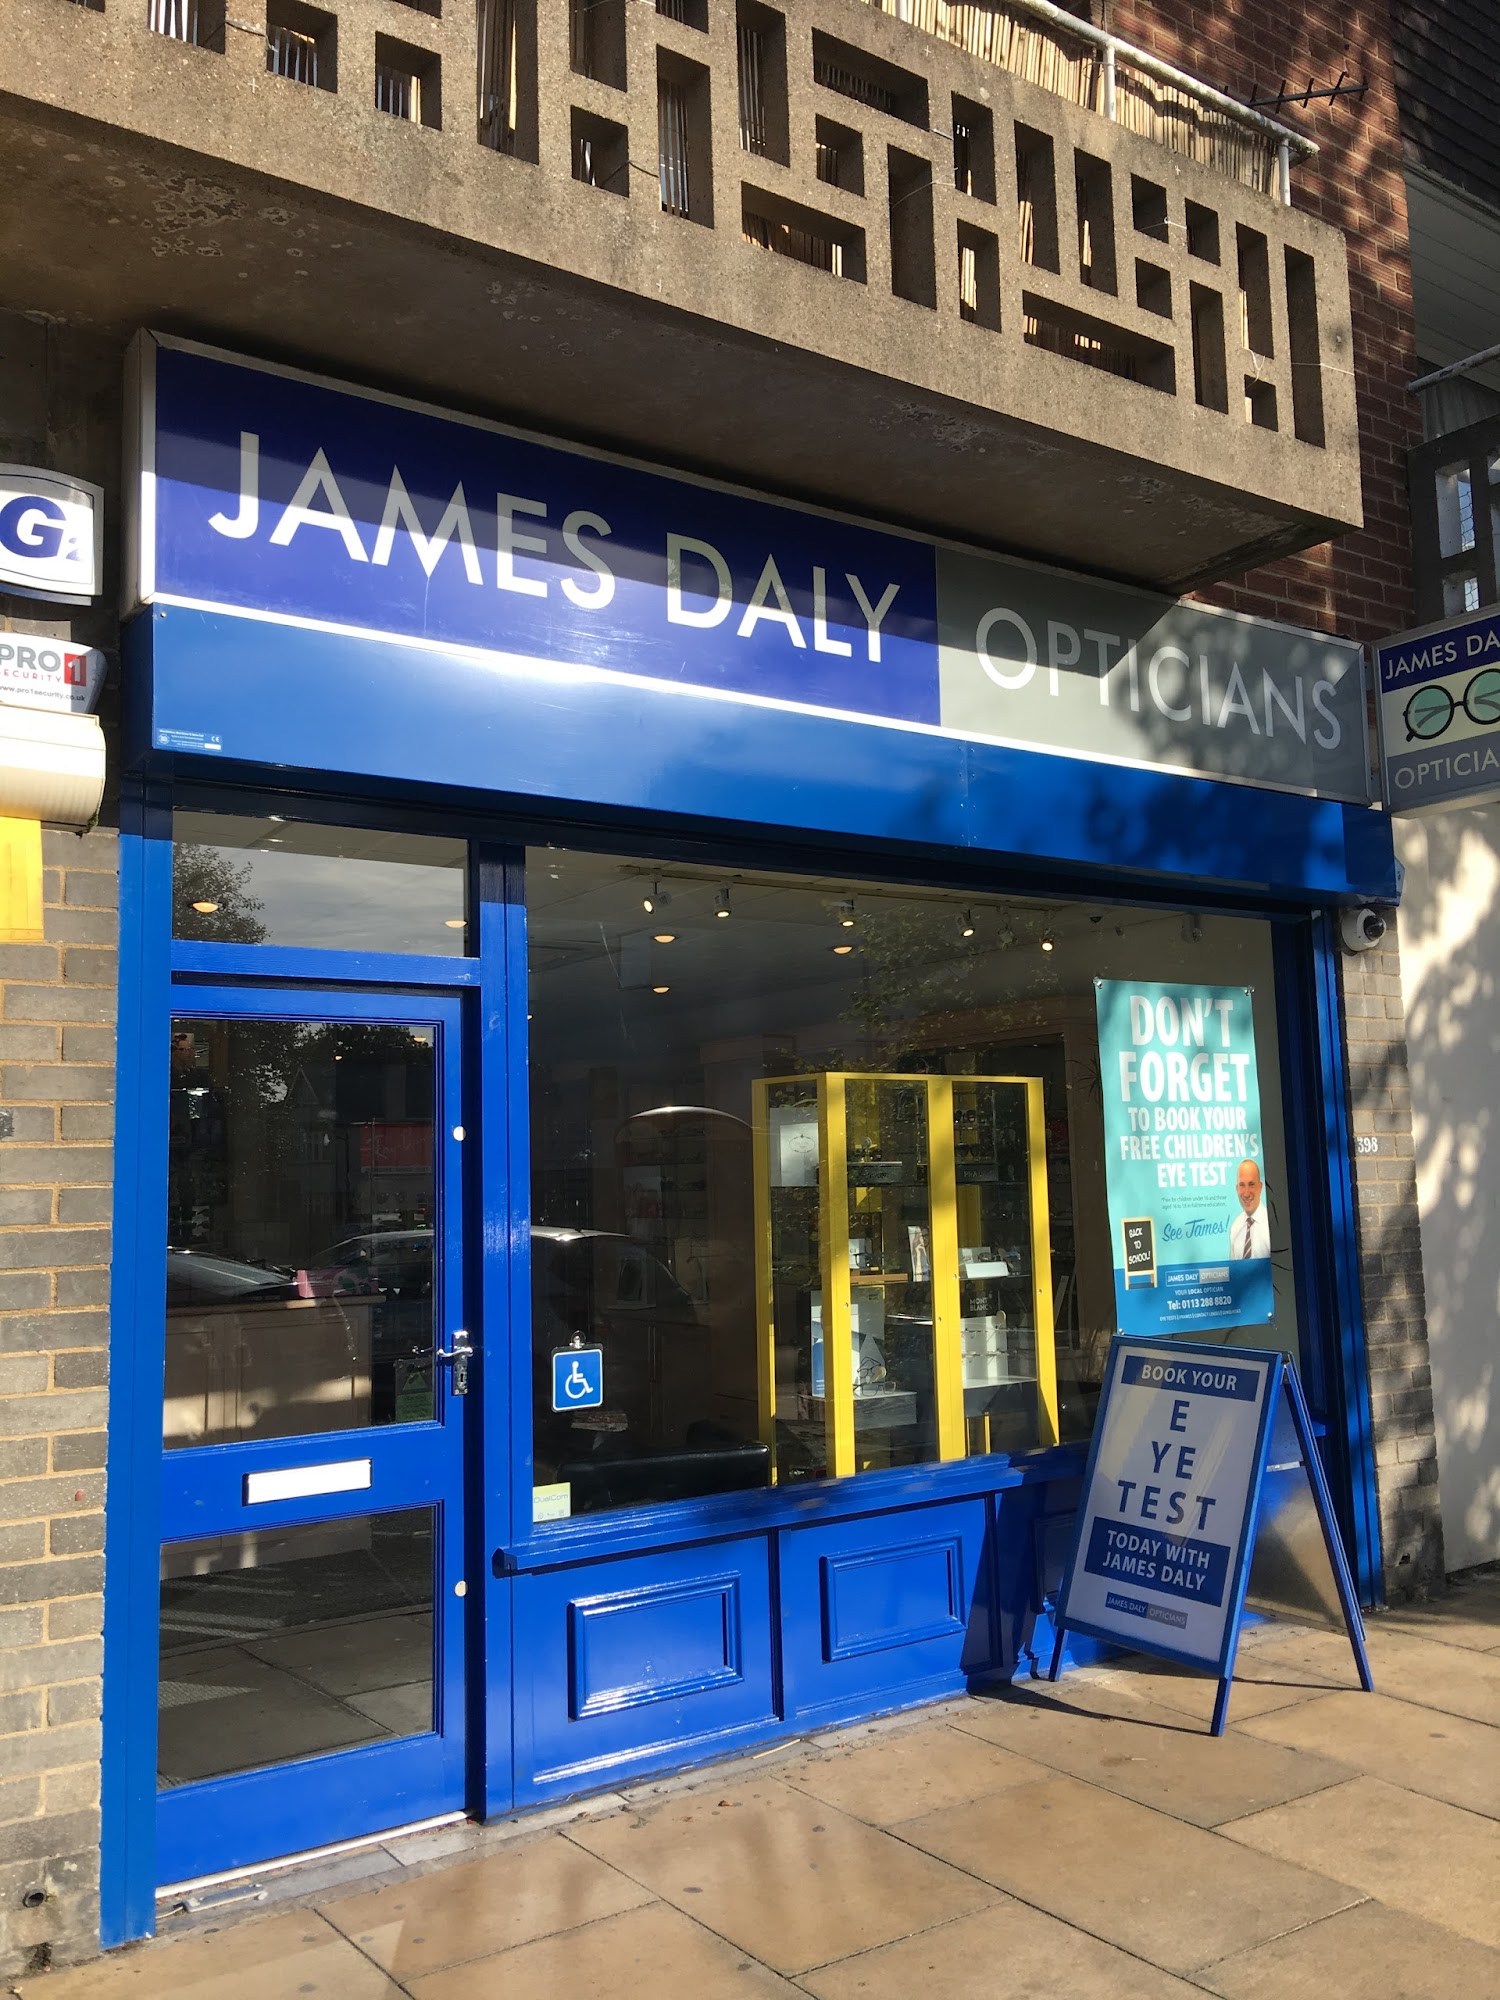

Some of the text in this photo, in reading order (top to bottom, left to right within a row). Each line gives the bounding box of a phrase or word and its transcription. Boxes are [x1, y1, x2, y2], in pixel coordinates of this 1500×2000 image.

[208, 430, 1342, 750] JAMES DALY OPTICIANS
[1385, 641, 1457, 680] JAMES
[0, 669, 61, 683] ECURITY
[1394, 747, 1500, 789] OPTICIA
[1130, 995, 1233, 1047] DON'T
[1118, 1051, 1250, 1103] FORGET
[1128, 1106, 1247, 1132] TO BOOK YOUR
[1120, 1133, 1259, 1160] FREE CHILDREN'S
[1357, 1136, 1378, 1153] 398
[1157, 1162, 1187, 1188] EYE
[1129, 1228, 1143, 1238] BACK
[1162, 1215, 1230, 1242] See James!
[1129, 1251, 1151, 1264] SCHOOL!
[1134, 1240, 1141, 1249] TO
[1167, 1271, 1229, 1282] JAMES DALY OPTICIANS
[970, 1297, 988, 1305] MONT
[970, 1304, 988, 1312] BLANC
[1167, 1296, 1232, 1310] Tel: 0113 288 8820
[1141, 1364, 1237, 1391] BOOK YOUR
[1169, 1400, 1190, 1433] E
[534, 1494, 568, 1503] DualCom
[1117, 1480, 1216, 1531] TEST
[1107, 1529, 1210, 1569] TODAY WITH
[1103, 1551, 1206, 1591] JAMES DALY
[1107, 1596, 1186, 1625] JAMES DALY OPTICIANS
